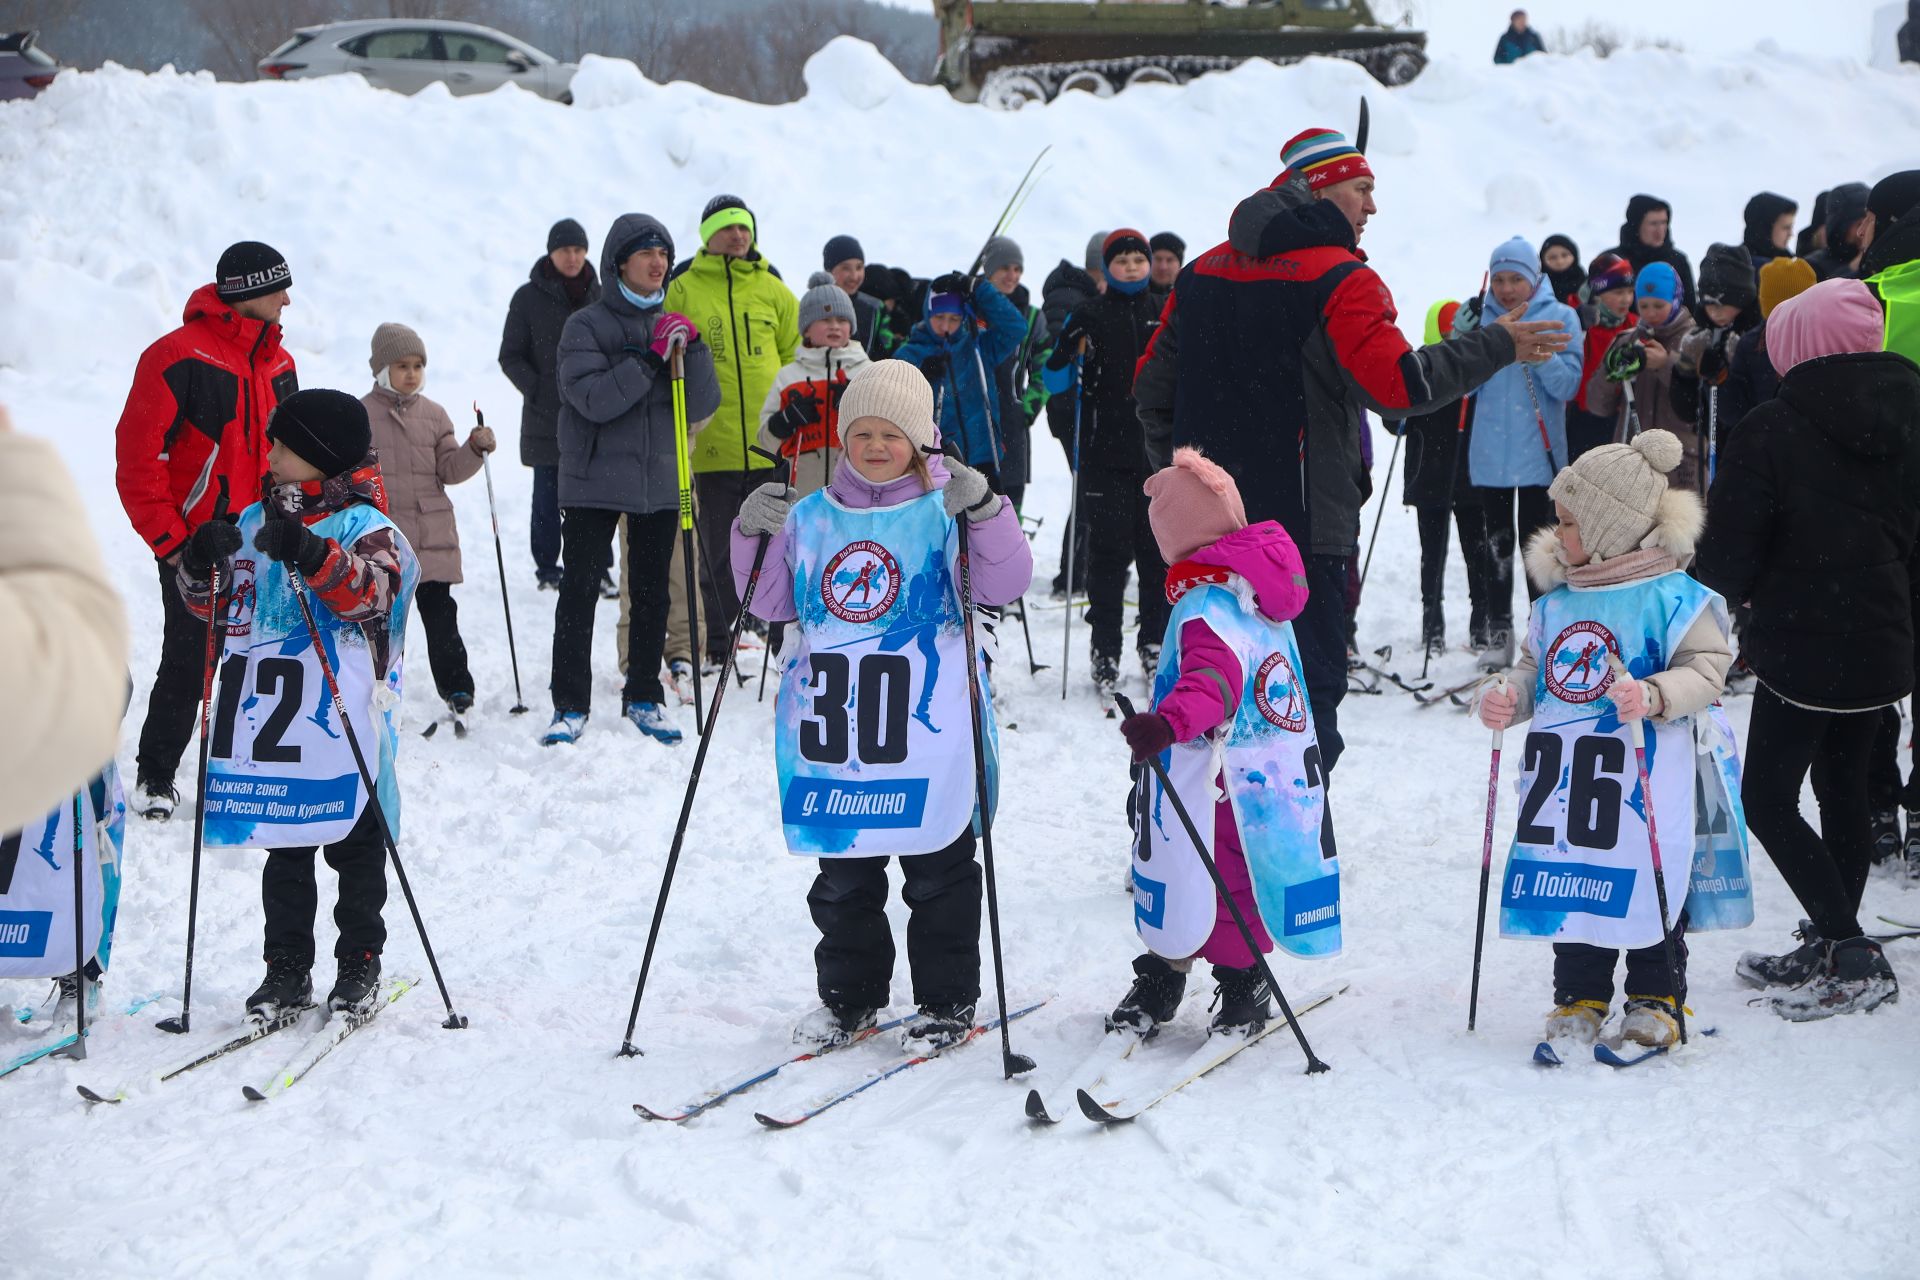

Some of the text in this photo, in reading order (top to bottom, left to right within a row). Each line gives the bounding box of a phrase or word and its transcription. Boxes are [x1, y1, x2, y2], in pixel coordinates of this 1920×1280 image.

[708, 316, 726, 362] NITRO
[839, 542, 886, 559] ЛЫЖНАЯ ГОНКА
[289, 571, 303, 595] TREK
[823, 573, 898, 620] ПАМЯТИ ГЕРОЯ РОССИИ ЮРИЯ КУРЯГИНА
[1562, 623, 1609, 639] ЛЫЖНАЯ ГОНКА
[1547, 677, 1562, 695] ГЕРОЯ
[1562, 691, 1586, 701] РОССИИ
[1586, 686, 1604, 699] ЮРИЯ
[211, 654, 304, 762] 12
[334, 693, 347, 715] TREK
[800, 653, 911, 764] 30
[1256, 692, 1272, 718] ПАМЯТИ
[1271, 714, 1291, 729] ГЕРОЯ
[209, 779, 288, 797] Лыжная гонка
[1517, 732, 1625, 850] 26
[225, 799, 264, 814] России
[266, 802, 295, 818] Юрия
[298, 801, 344, 819] Курягина
[802, 789, 906, 816] д. Пойкино
[1511, 871, 1613, 902] д. Пойкино
[1295, 904, 1335, 927] памяти
